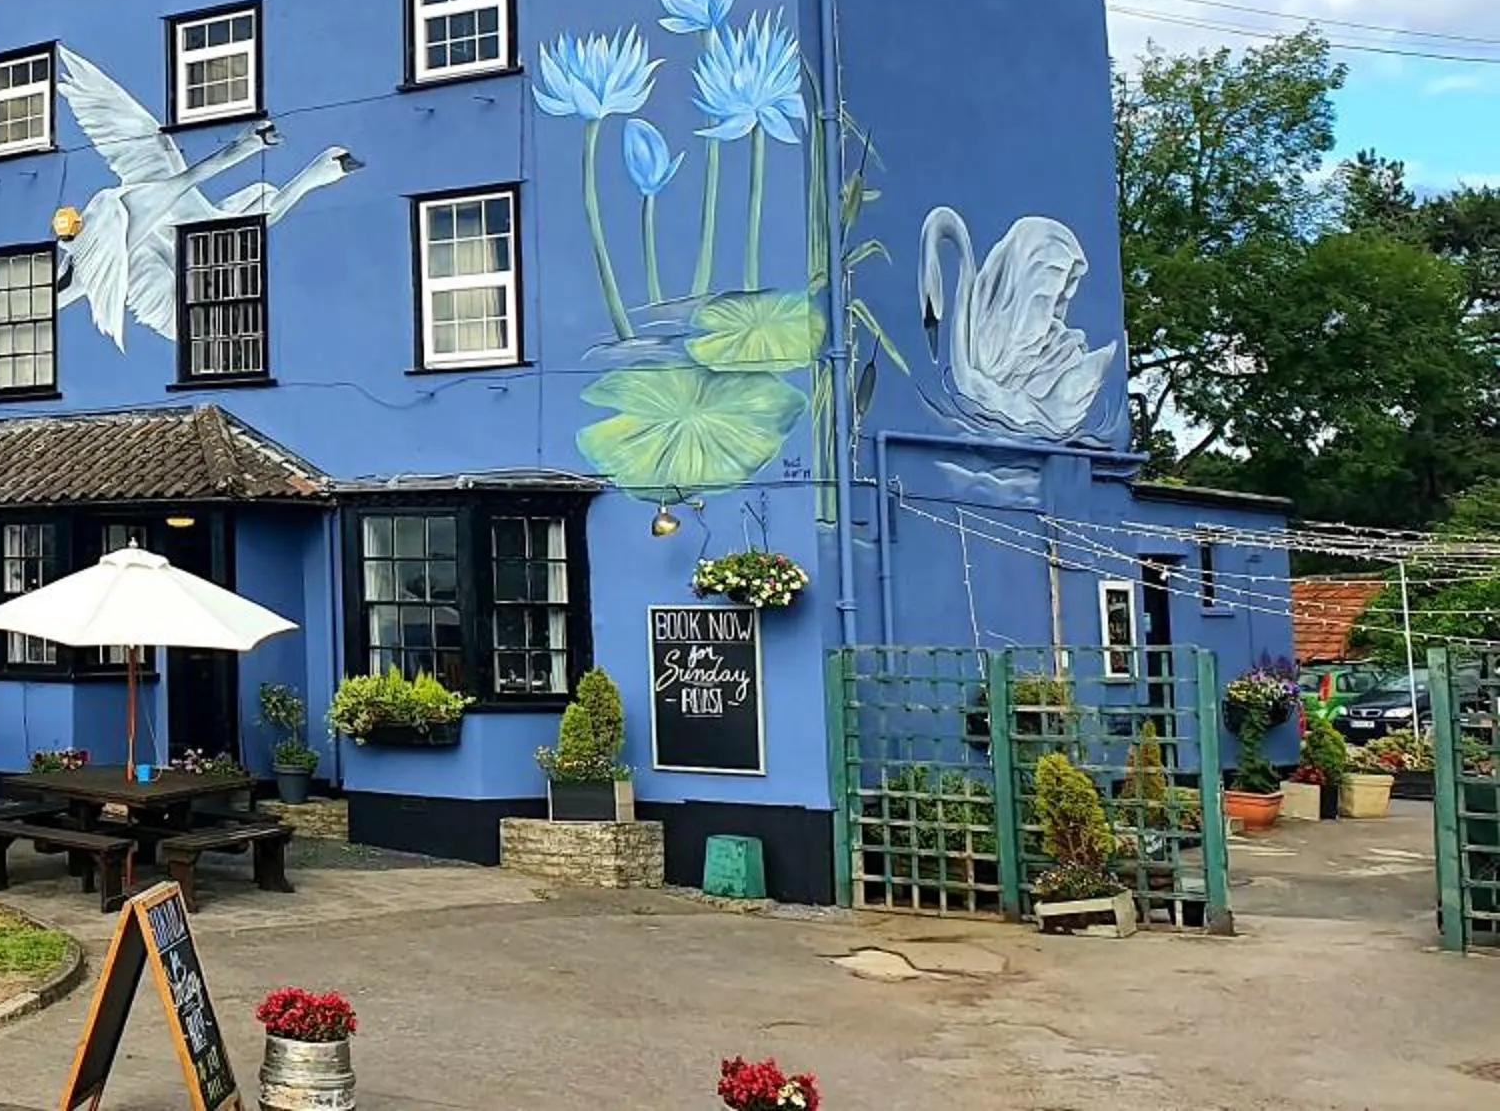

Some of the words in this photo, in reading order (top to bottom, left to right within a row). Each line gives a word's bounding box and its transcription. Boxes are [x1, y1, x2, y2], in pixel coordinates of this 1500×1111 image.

[655, 611, 701, 640] BOOK
[709, 612, 753, 640] NOW
[688, 645, 717, 668] for
[656, 649, 750, 702] Sunday
[682, 688, 723, 714] ROAST
